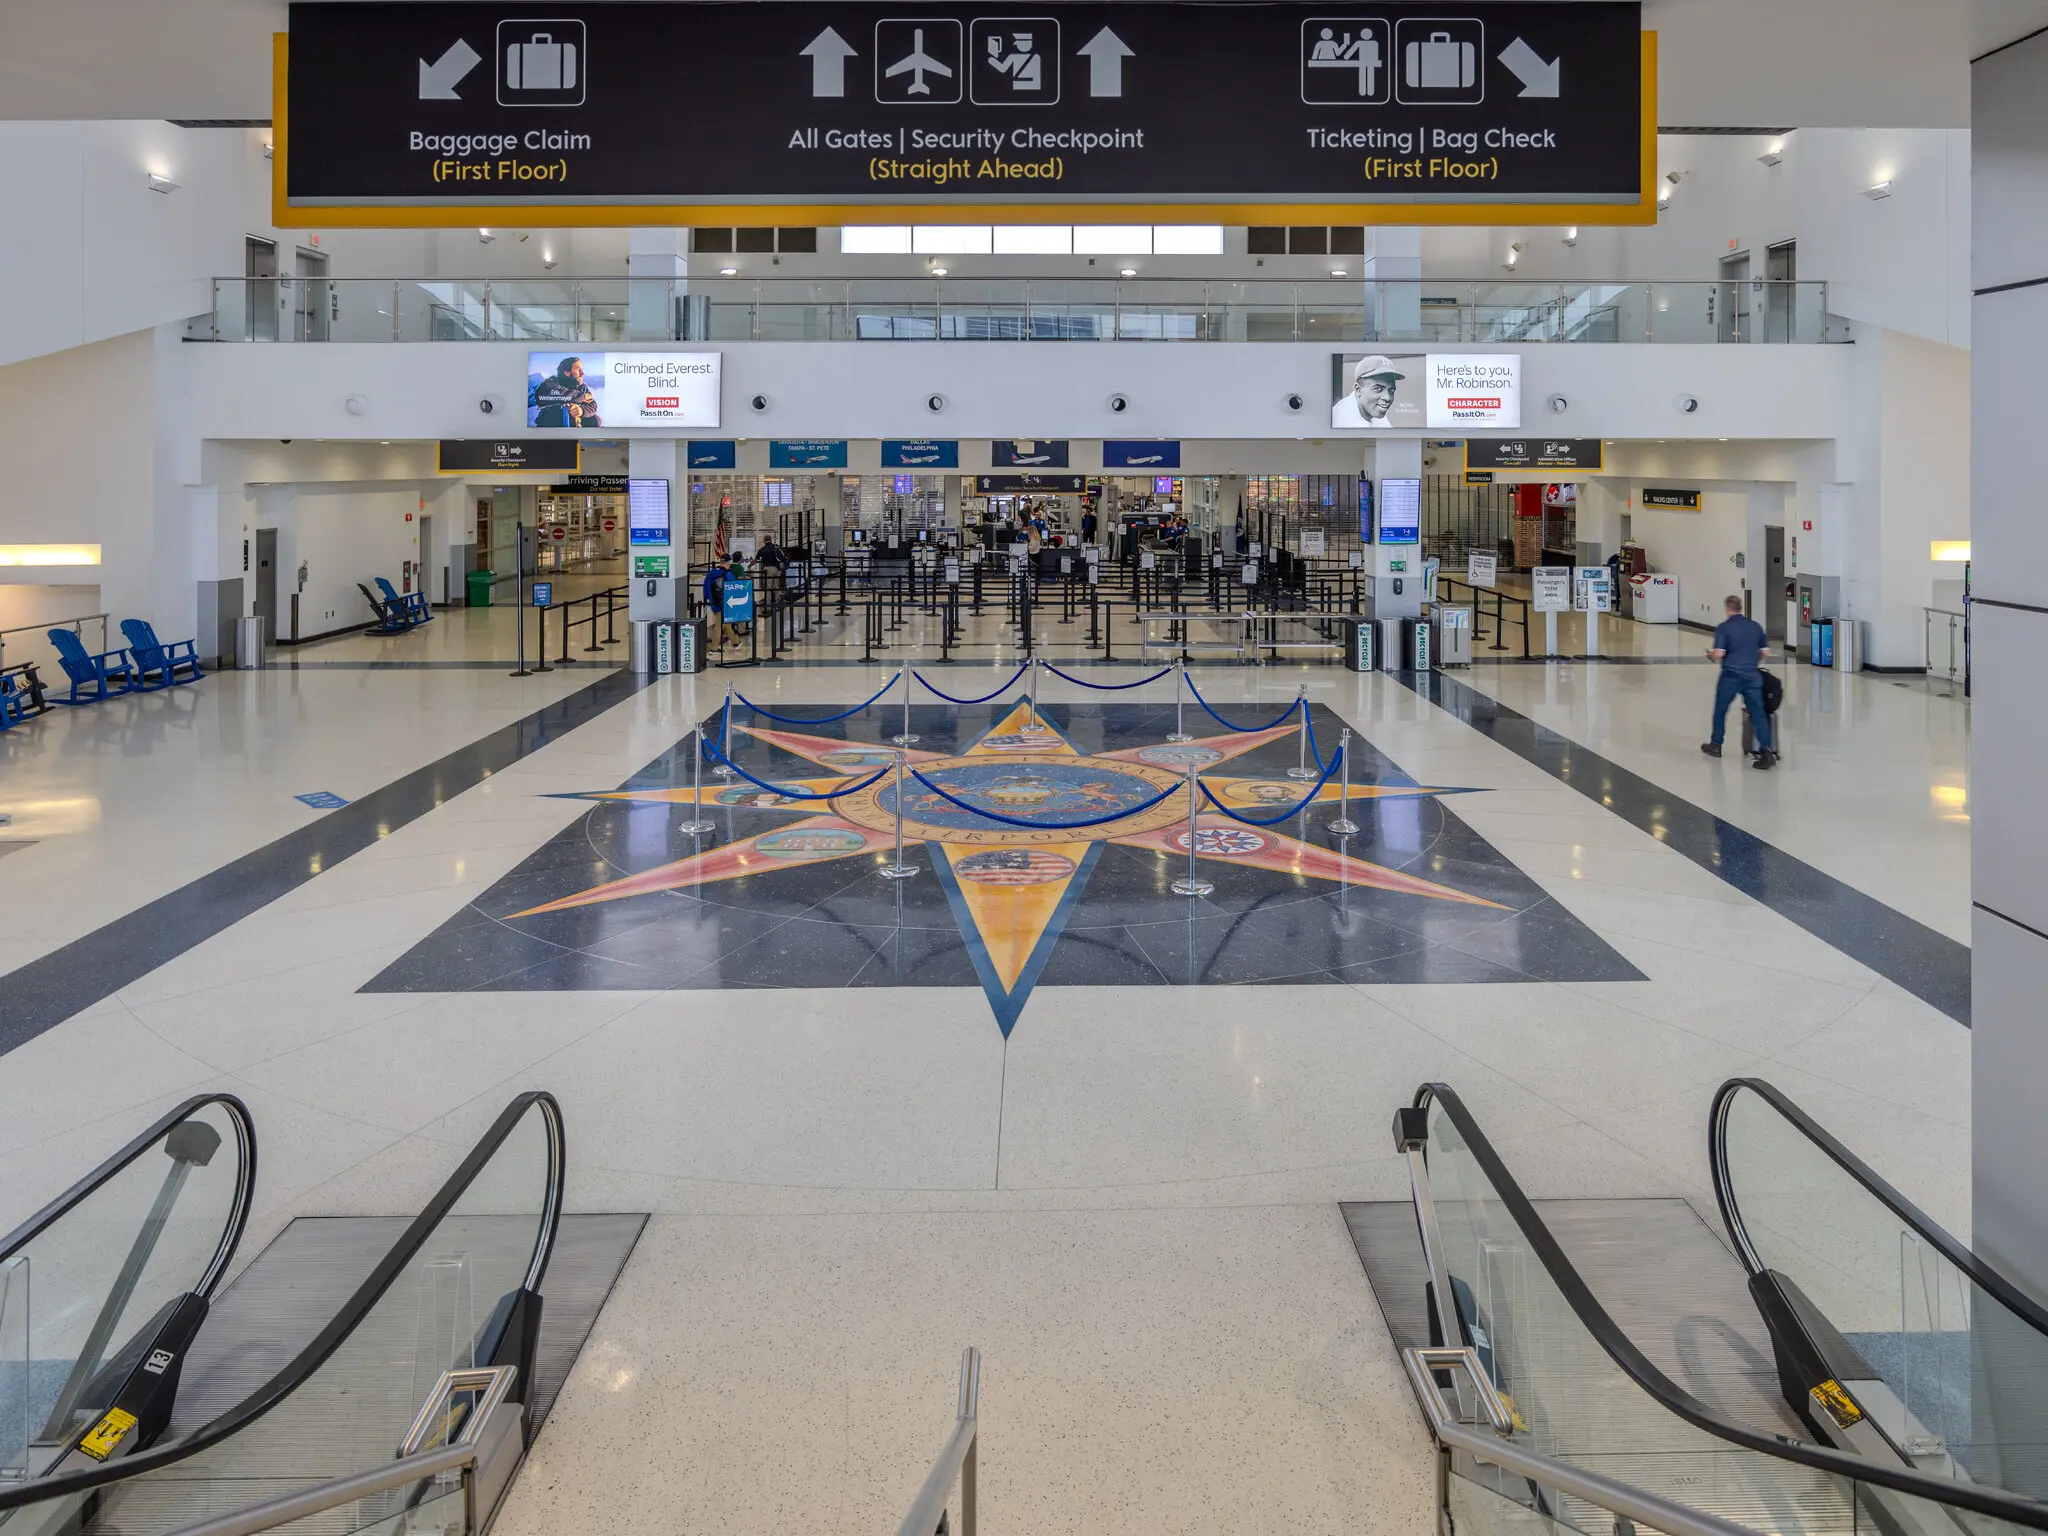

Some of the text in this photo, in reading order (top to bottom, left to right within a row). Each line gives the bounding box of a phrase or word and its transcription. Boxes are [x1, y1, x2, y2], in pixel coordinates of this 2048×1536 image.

[411, 129, 591, 156] Baggage Claim
[789, 128, 817, 148] All
[826, 129, 893, 149] Gates
[911, 128, 1005, 154] Security
[1012, 127, 1144, 154] Checkpoint
[1307, 127, 1413, 153] Ticketing
[1432, 128, 1478, 153] Bag
[1485, 127, 1556, 148] Check
[433, 158, 567, 182] (First Floor)
[869, 156, 1063, 184] (Straight Ahead)
[1364, 156, 1498, 180] (First Floor)
[614, 362, 714, 375] Climbed Everest.
[1437, 365, 1513, 377] Here's to you,
[648, 376, 680, 388] Blind.
[1437, 378, 1513, 389] Mr. Robinson.
[1653, 578, 1676, 586] FedEx
[918, 827, 1114, 842] AIRPORT
[148, 1351, 171, 1369] 13
